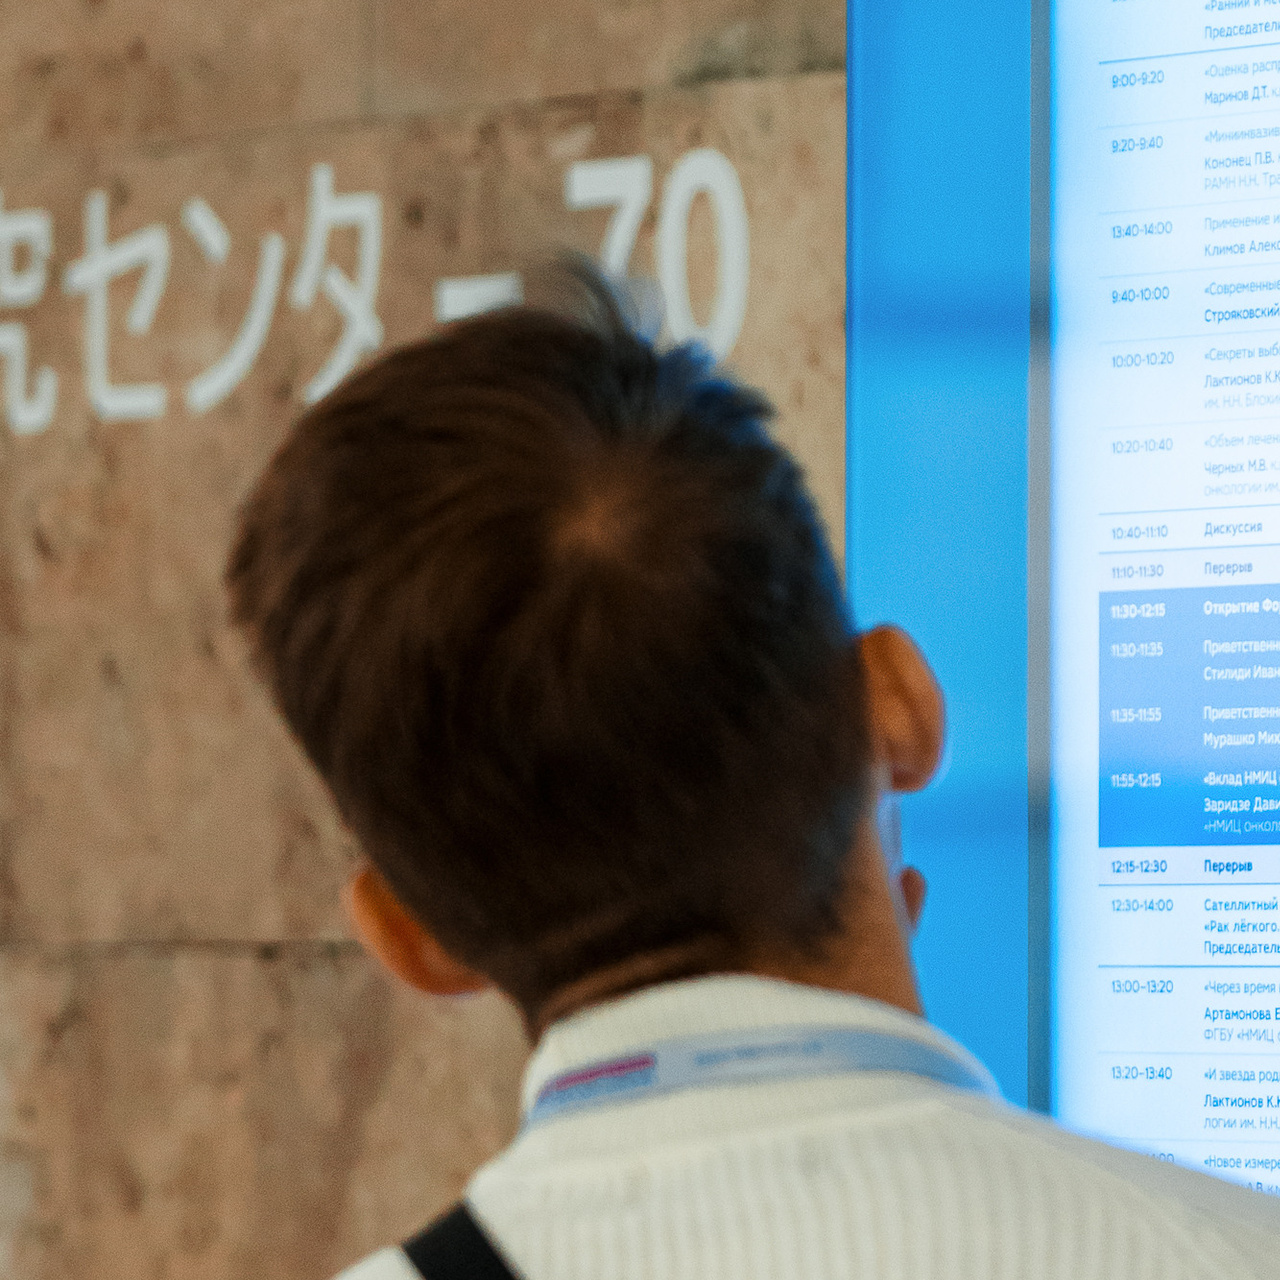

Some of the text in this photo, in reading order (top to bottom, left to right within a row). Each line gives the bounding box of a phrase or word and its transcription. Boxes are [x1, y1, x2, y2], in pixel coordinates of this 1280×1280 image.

[1203, 522, 1263, 537] Дискуссия
[1204, 561, 1253, 576] Перерыв
[1202, 600, 1260, 616] Открытие
[1203, 732, 1256, 748] Мурашко
[1243, 770, 1278, 786] НМИЦ
[1204, 859, 1253, 874] Перерыв
[1203, 897, 1279, 912] Сателлитный
[1243, 982, 1276, 996] время
[1219, 1069, 1256, 1082] звезда
